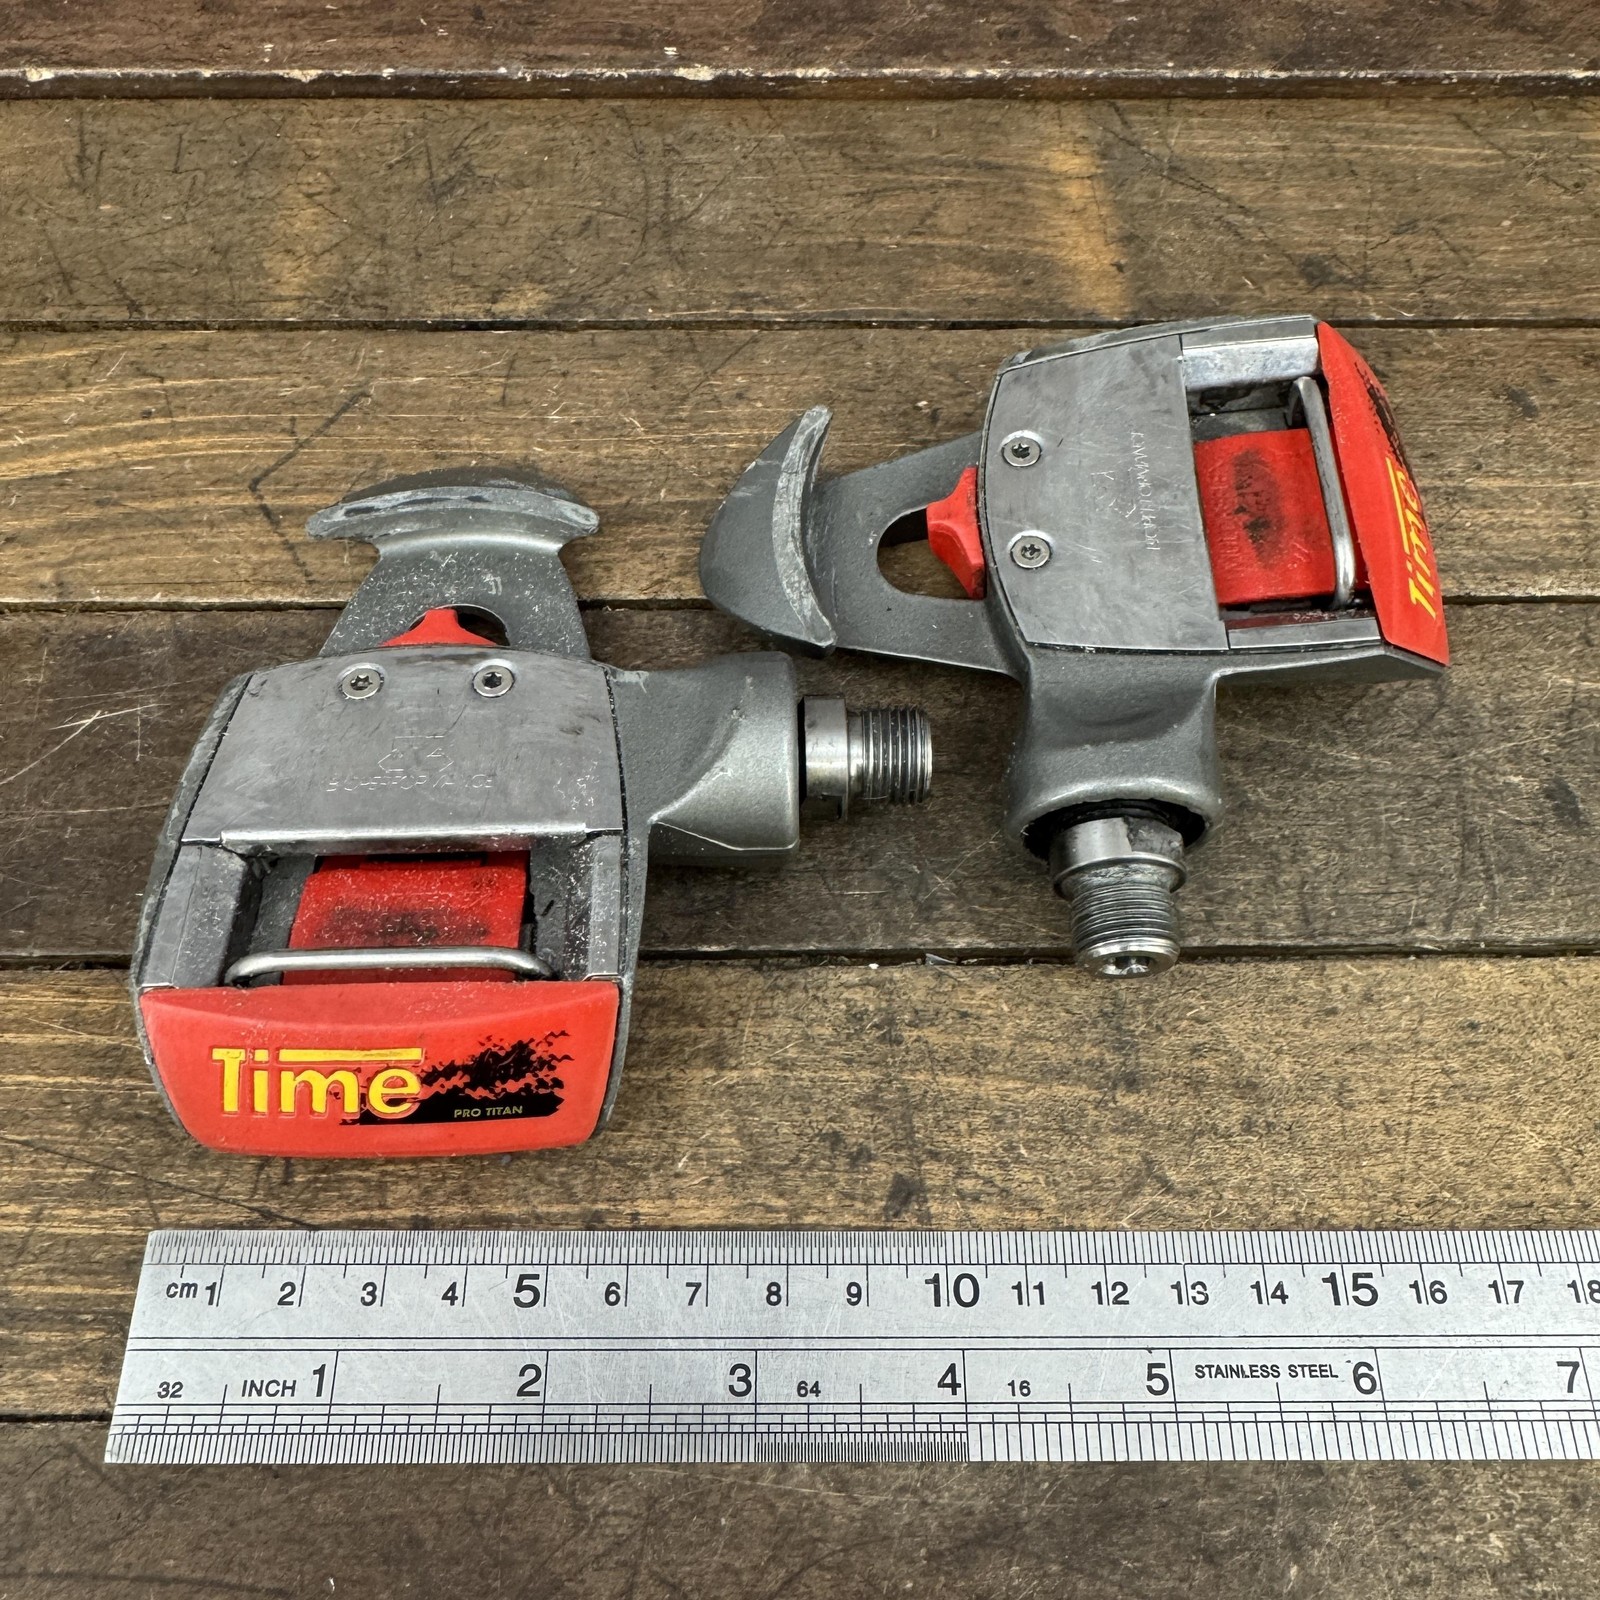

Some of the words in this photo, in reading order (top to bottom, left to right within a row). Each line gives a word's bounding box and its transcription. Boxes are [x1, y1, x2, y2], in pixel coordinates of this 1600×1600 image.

[1386, 457, 1437, 620] Time
[211, 1047, 423, 1114] Time
[453, 1107, 482, 1118] PRO
[485, 1105, 523, 1116] TITAN
[166, 1282, 198, 1299] cm
[205, 1281, 217, 1306] 1
[277, 1281, 296, 1306] 2
[360, 1281, 378, 1307] 3
[441, 1281, 459, 1307] 4
[513, 1273, 541, 1309] 5
[604, 1281, 621, 1307] 6
[685, 1281, 702, 1306] 7
[765, 1281, 782, 1307] 8
[846, 1281, 862, 1307] 9
[924, 1272, 980, 1308] 10
[1011, 1281, 1045, 1306] 11
[1091, 1281, 1130, 1306] 12
[1170, 1280, 1209, 1306] 13
[1250, 1280, 1289, 1305] 14
[1321, 1271, 1379, 1307] 15
[1408, 1280, 1448, 1305] 16
[1488, 1279, 1525, 1304] 17
[1567, 1279, 1600, 1304] 18
[157, 1381, 184, 1399] 32
[241, 1379, 297, 1397] INCH
[312, 1363, 327, 1398] 1
[516, 1363, 542, 1397] 2
[728, 1363, 753, 1398] 3
[796, 1380, 822, 1398] 64
[937, 1362, 962, 1396] 4
[1007, 1379, 1031, 1397] 16
[1146, 1362, 1170, 1396] 5
[1352, 1361, 1377, 1395] 6
[1556, 1361, 1580, 1393] 7
[1194, 1364, 1281, 1379] STAINLESS
[1288, 1364, 1339, 1379] STEEL
